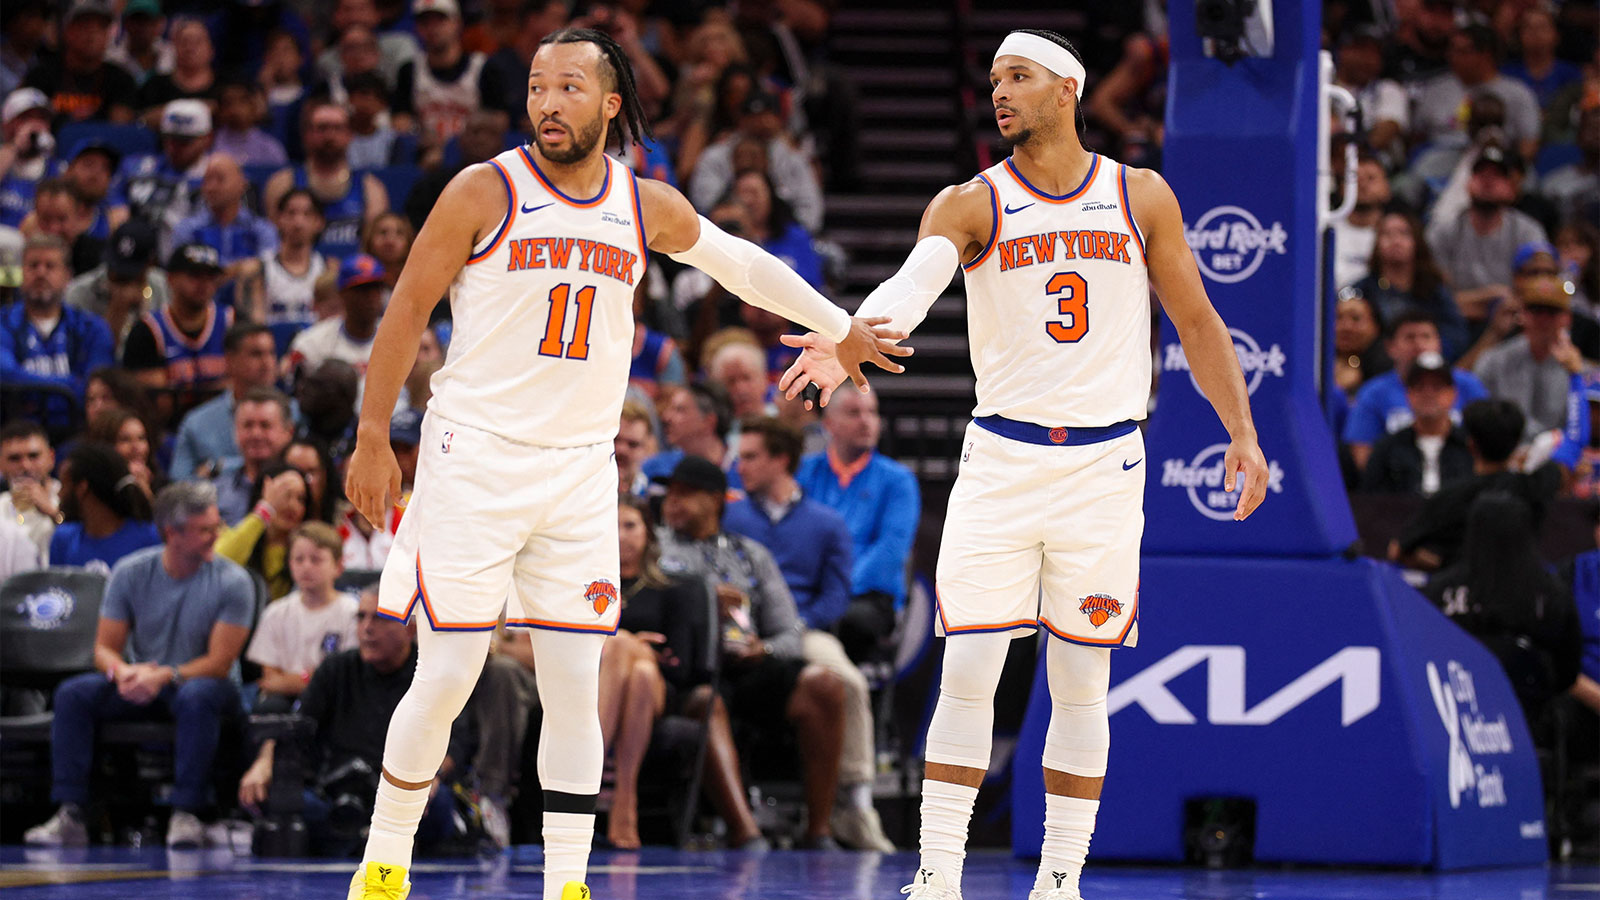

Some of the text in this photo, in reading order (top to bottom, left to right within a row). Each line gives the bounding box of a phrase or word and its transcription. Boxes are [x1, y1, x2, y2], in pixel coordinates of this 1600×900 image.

[998, 230, 1131, 272] NEW YORK
[1227, 221, 1288, 255] Rock
[507, 237, 638, 287] NEW YORK
[1211, 253, 1244, 270] BET
[537, 282, 597, 361] 11
[1045, 271, 1089, 343] 3
[1161, 459, 1225, 487] Hard
[584, 581, 618, 601] KNICKS
[1079, 595, 1122, 615] KNICKS
[1108, 645, 1381, 727] KIA
